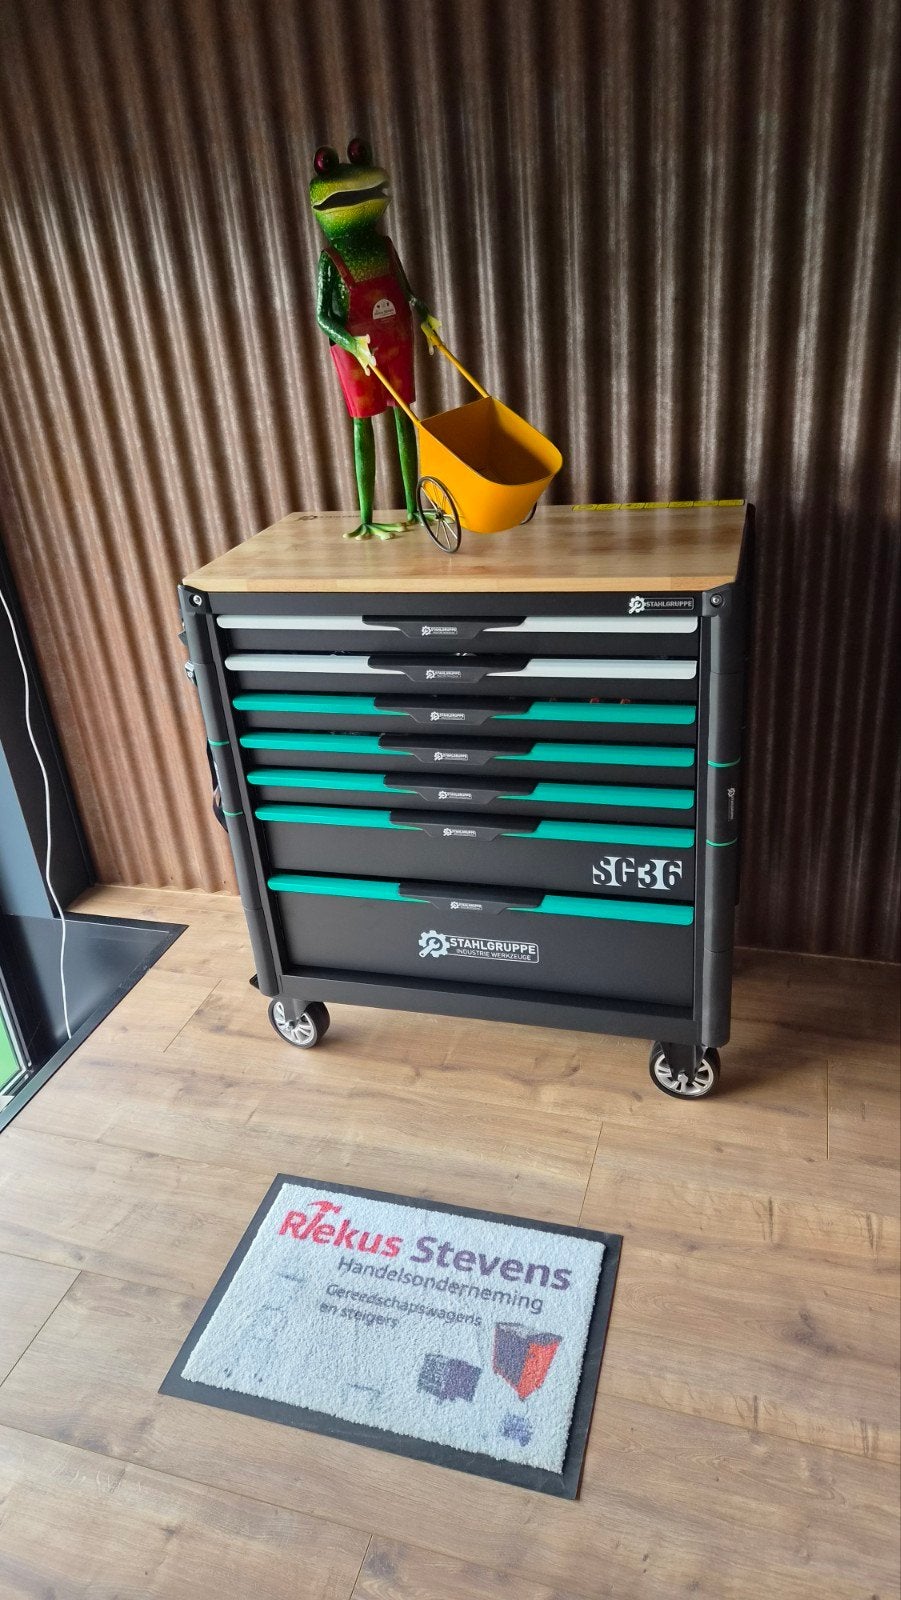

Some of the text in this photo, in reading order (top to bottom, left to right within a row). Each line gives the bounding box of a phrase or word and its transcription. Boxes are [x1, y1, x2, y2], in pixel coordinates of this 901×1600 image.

[646, 600, 692, 608] STAHLGRUPPE
[592, 856, 683, 890] SG36
[450, 938, 536, 954] STAHLGRUPPE
[456, 948, 532, 961] INDUSTRIE WERKZEUGE
[278, 1200, 573, 1290] Riekus Stevens
[338, 1256, 544, 1315] Handelsonderneming
[319, 1302, 400, 1328] en steigers
[326, 1284, 483, 1327] Gereedschapswagens
